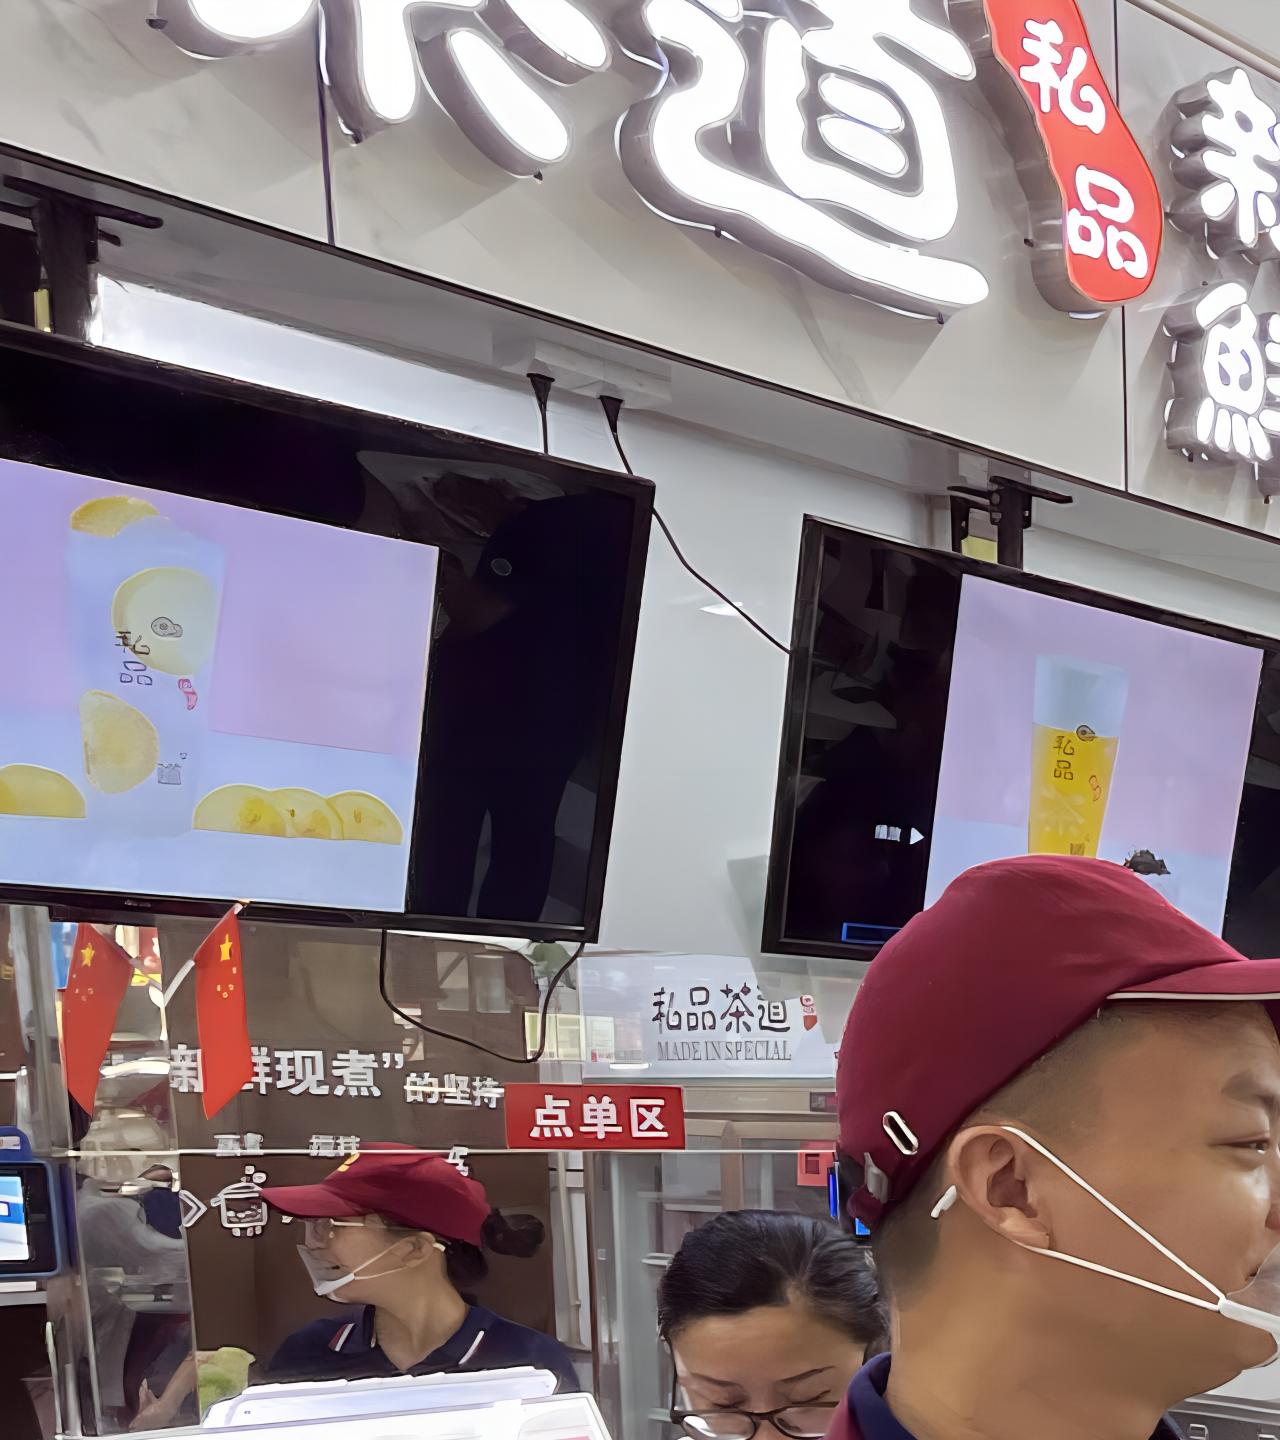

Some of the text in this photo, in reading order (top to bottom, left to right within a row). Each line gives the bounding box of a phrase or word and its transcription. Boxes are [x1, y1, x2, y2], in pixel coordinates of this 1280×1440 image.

[1020, 19, 1150, 280] 私品
[657, 1040, 792, 1061] MADE IN SPECIAL
[529, 1094, 669, 1139] 点单区
